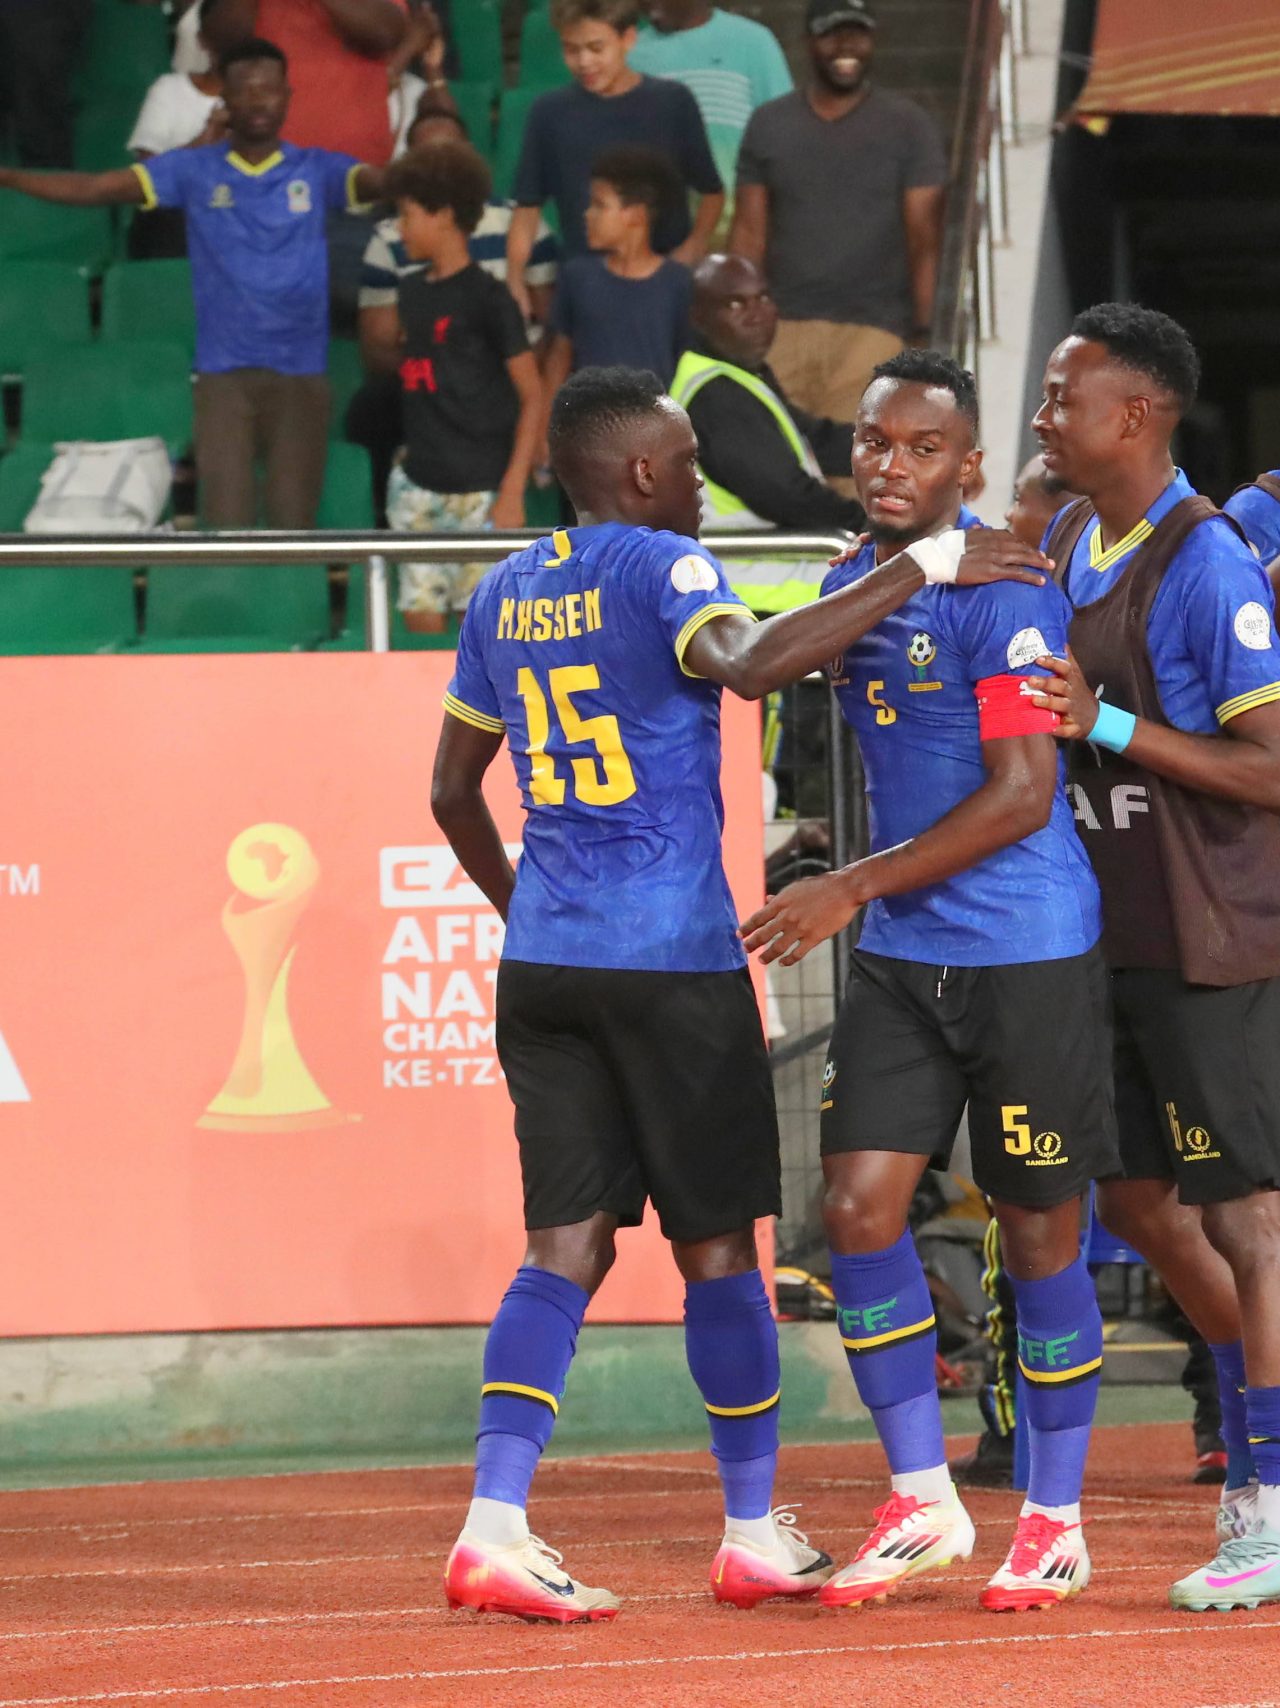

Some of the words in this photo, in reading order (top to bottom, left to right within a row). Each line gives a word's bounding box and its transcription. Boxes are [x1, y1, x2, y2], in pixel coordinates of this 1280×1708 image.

[867, 681, 896, 725] 5
[516, 664, 637, 806] 15
[1065, 783, 1150, 830] AF
[1001, 1105, 1031, 1155] 5
